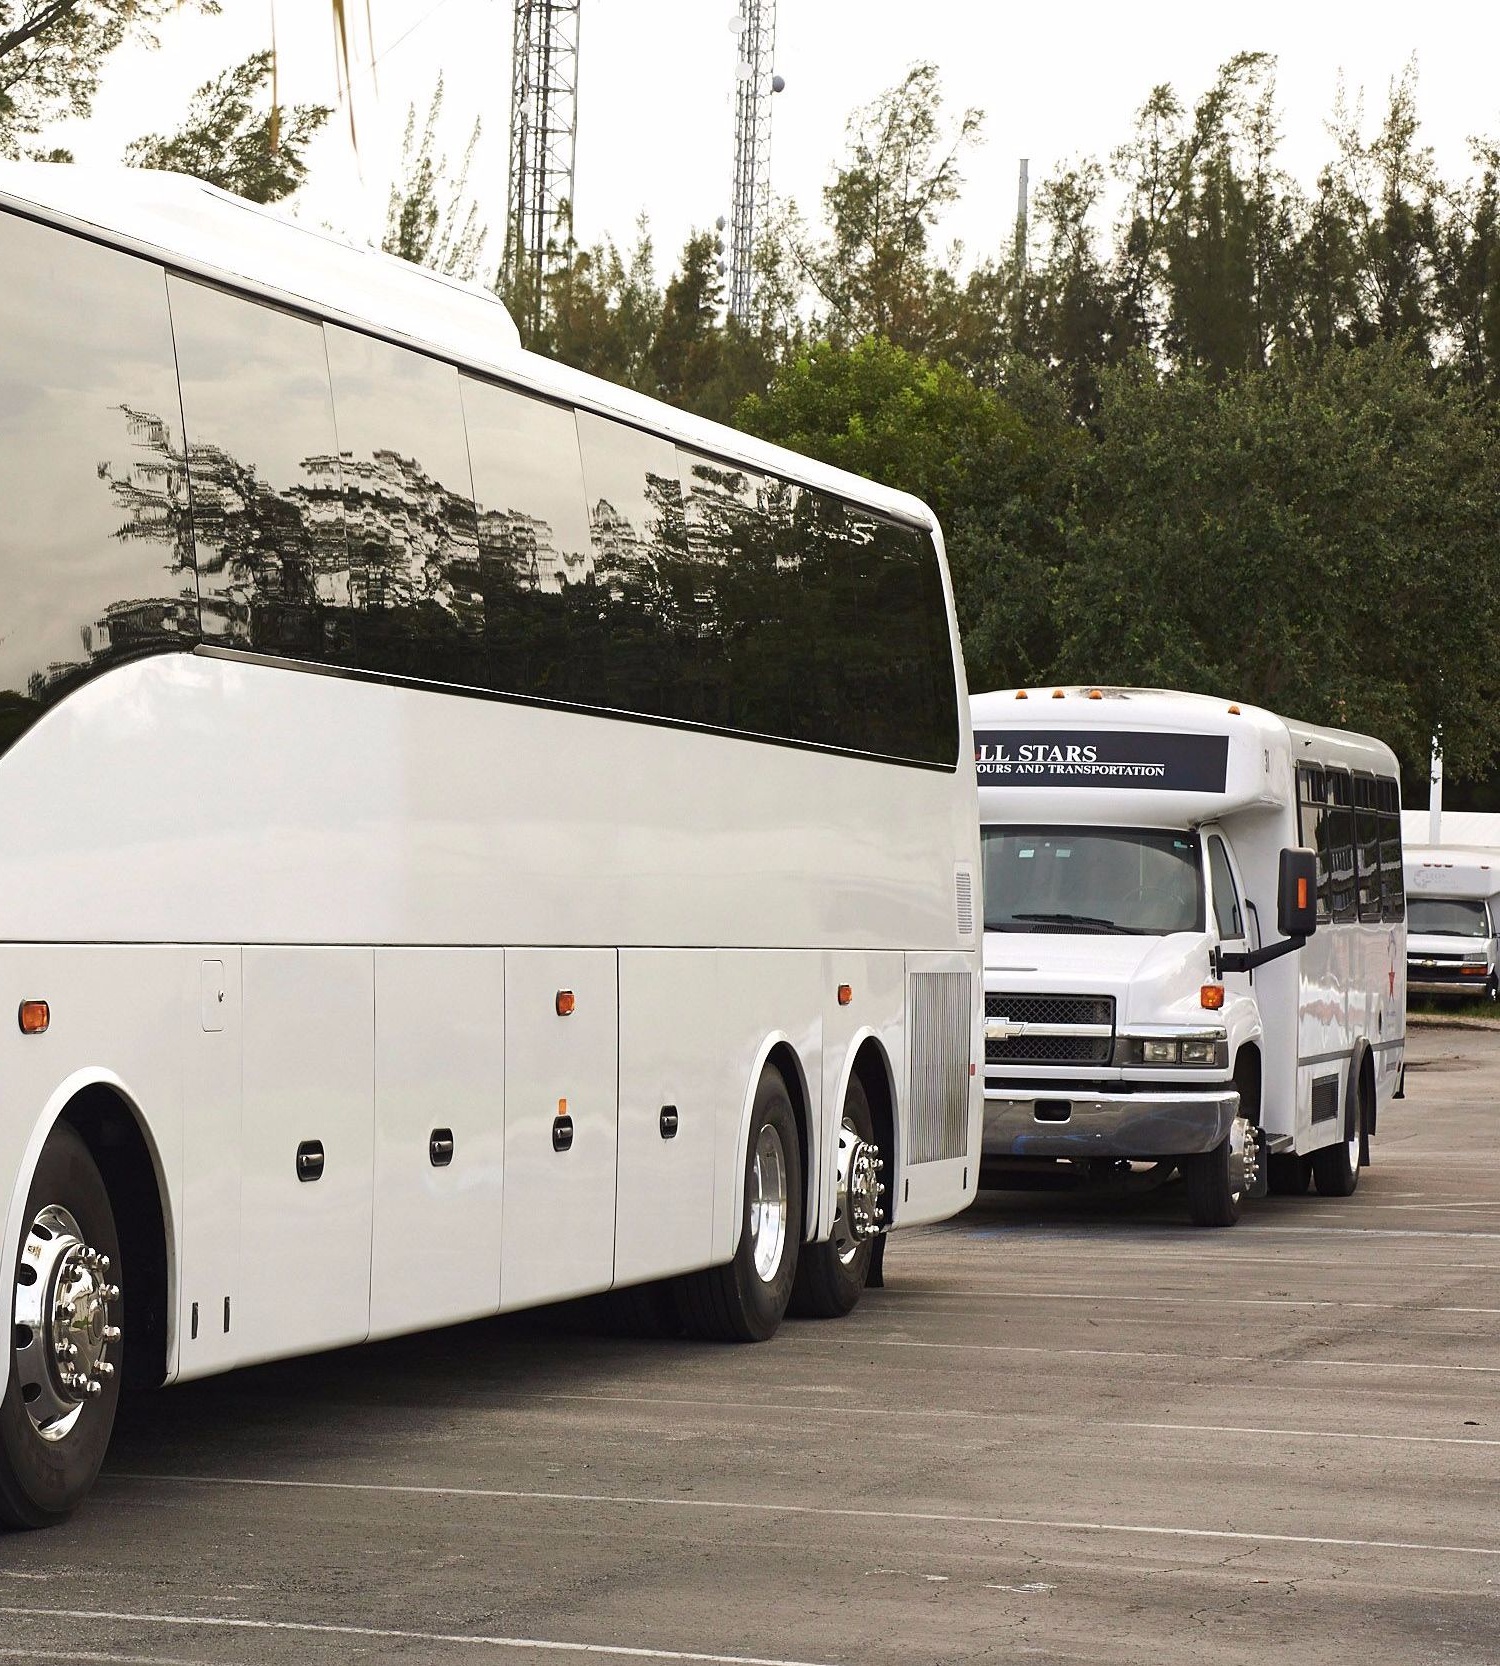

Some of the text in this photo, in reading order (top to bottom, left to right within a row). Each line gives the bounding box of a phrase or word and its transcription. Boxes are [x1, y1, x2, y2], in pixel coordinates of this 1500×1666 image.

[975, 744, 1097, 763] LL STARS
[975, 764, 1165, 777] OURS AND TRANSPORTATION
